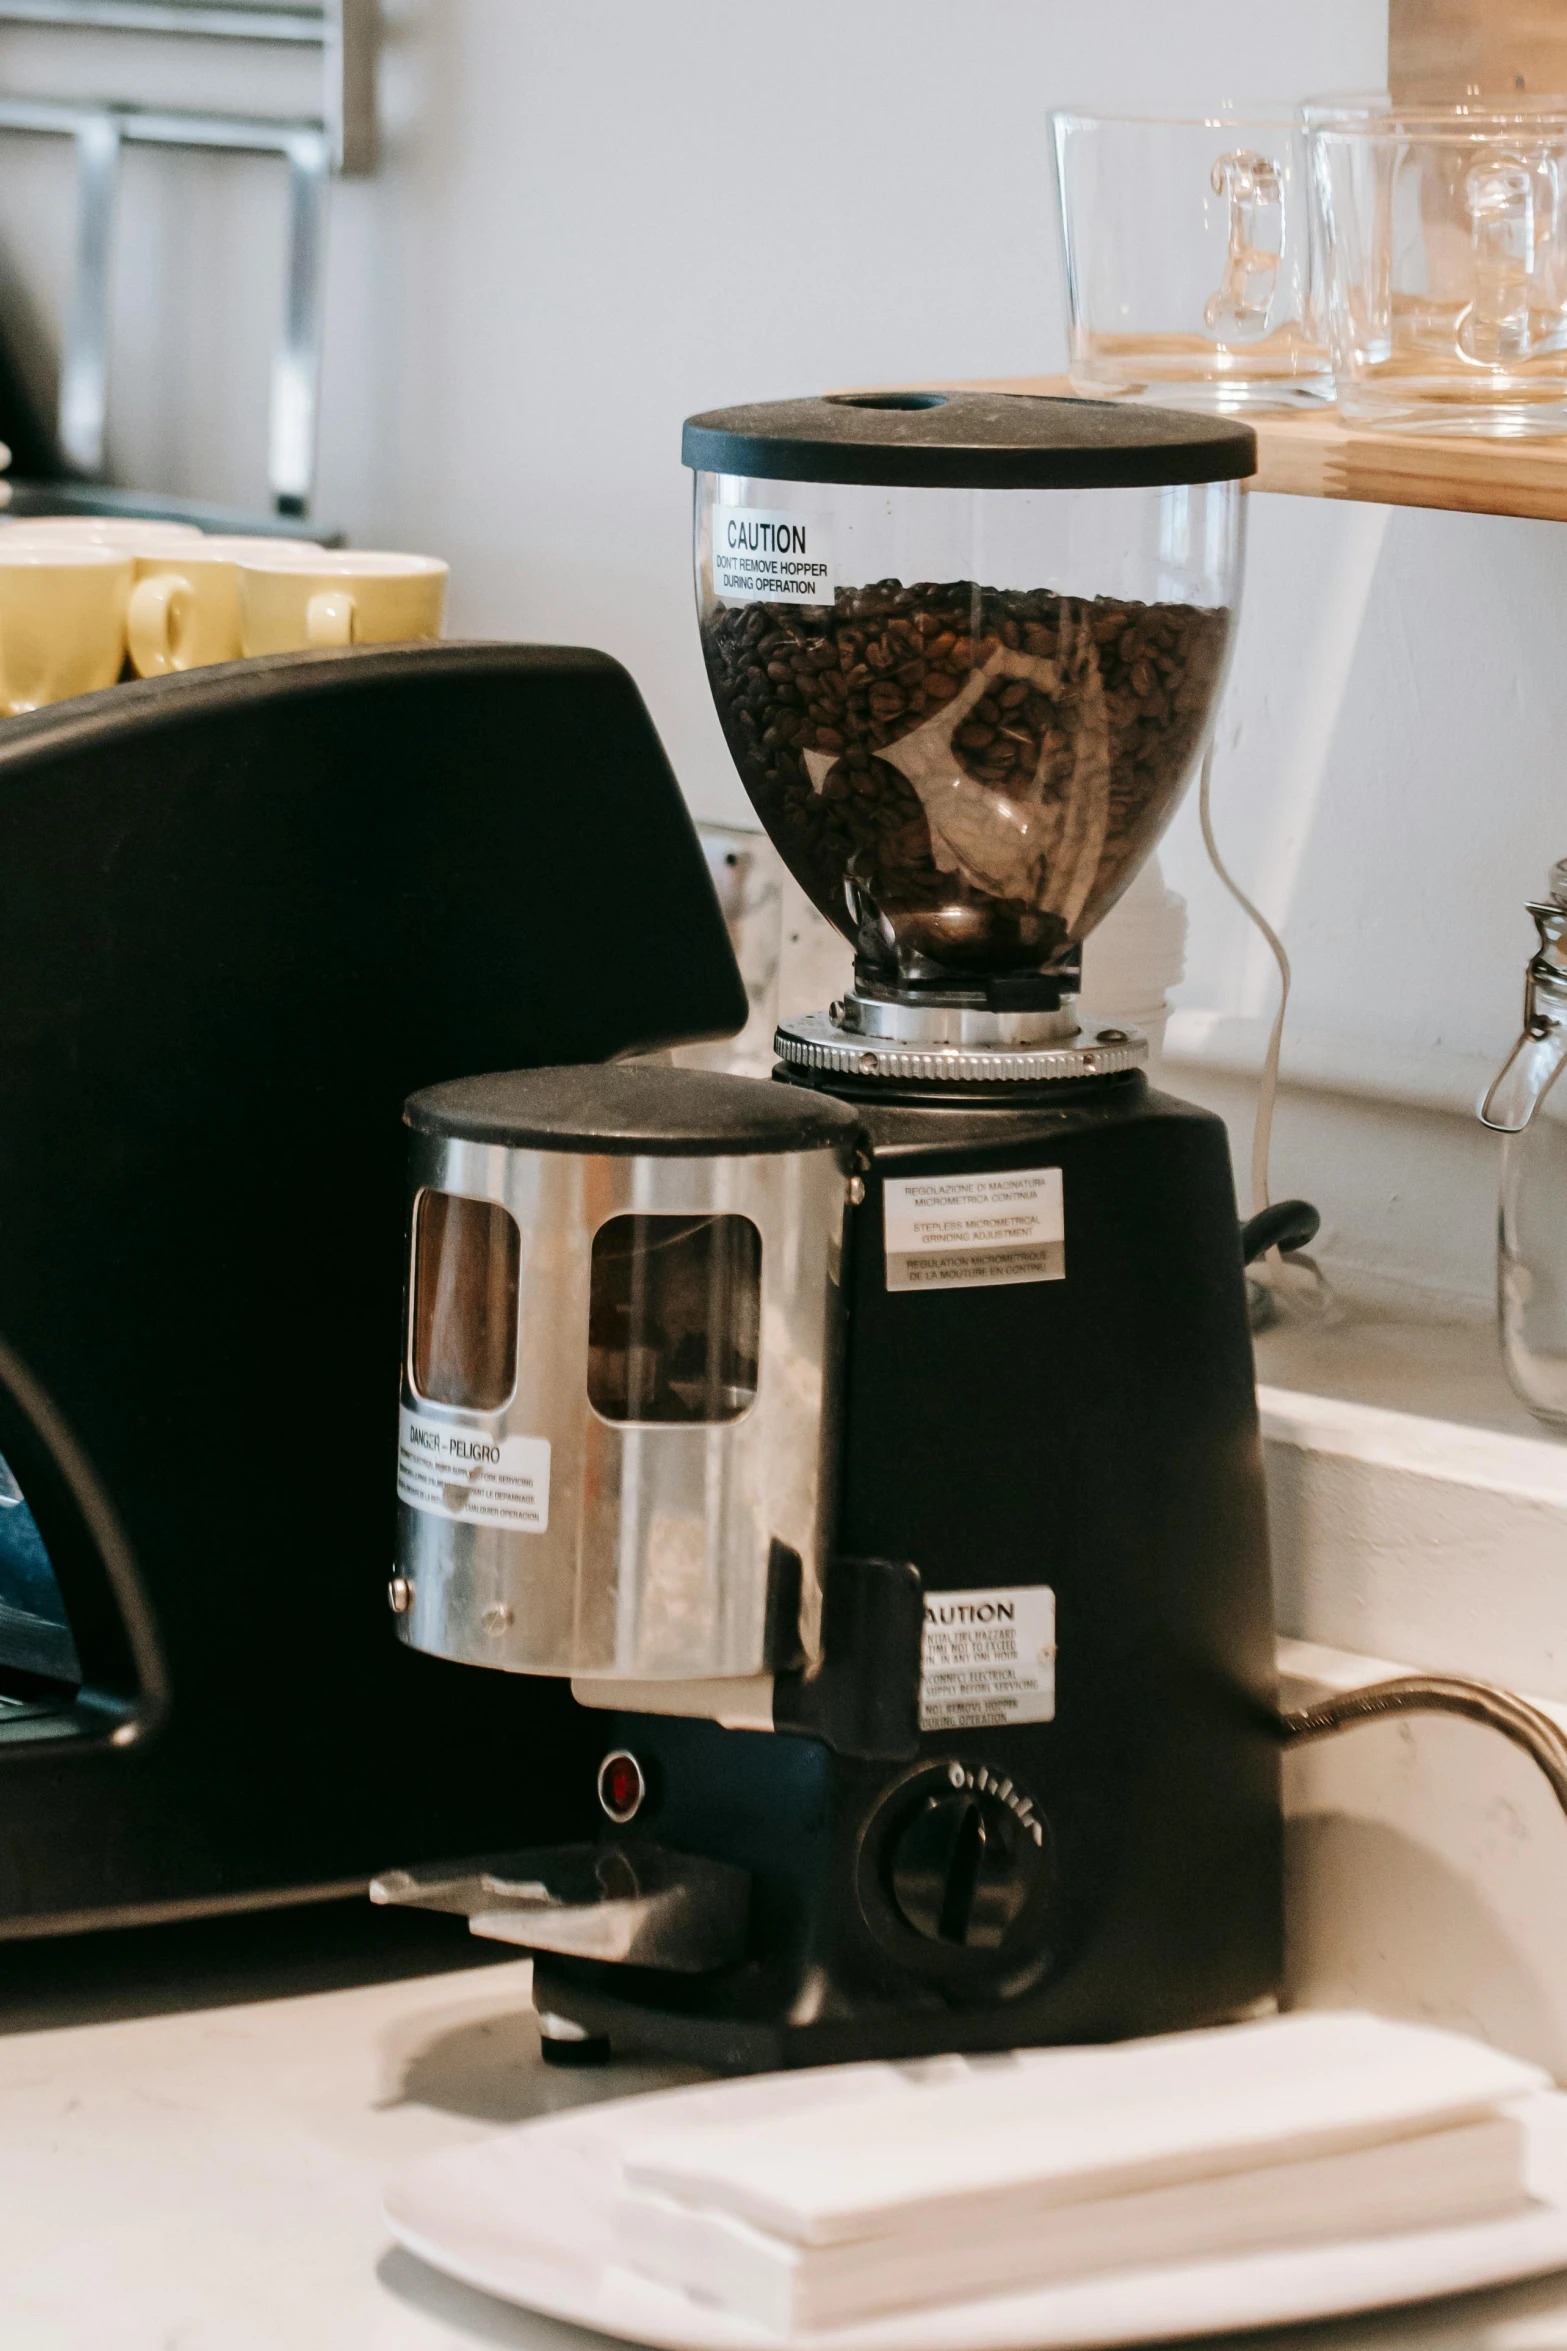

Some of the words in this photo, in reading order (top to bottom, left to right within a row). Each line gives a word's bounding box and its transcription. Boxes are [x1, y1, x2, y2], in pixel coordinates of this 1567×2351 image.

[728, 520, 805, 554] CAUTION
[717, 555, 738, 570] DON'T
[740, 559, 778, 574] REMOVE
[780, 562, 827, 577] HOPPER
[723, 574, 753, 590] DURING
[756, 578, 815, 594] OPERATION
[905, 1184, 974, 1196] REGOLAZIONE
[977, 1183, 987, 1192] DI
[914, 1195, 989, 1207] MICROMETRICA
[992, 1191, 1038, 1202] CONTINUA
[913, 1221, 963, 1232] STEPLESS
[965, 1216, 1041, 1229] MICROMETRICAL
[922, 1233, 970, 1244] GRINDING
[973, 1228, 1033, 1241] ADJUSTMENT
[926, 1271, 937, 1280] LA
[410, 1425, 440, 1453] DANGER
[450, 1438, 500, 1465] PELIGRO
[926, 1602, 1015, 1625] AUTION
[951, 1643, 968, 1653] NOT
[972, 1643, 983, 1652] TO
[969, 1669, 1017, 1682] ELECTRICAL
